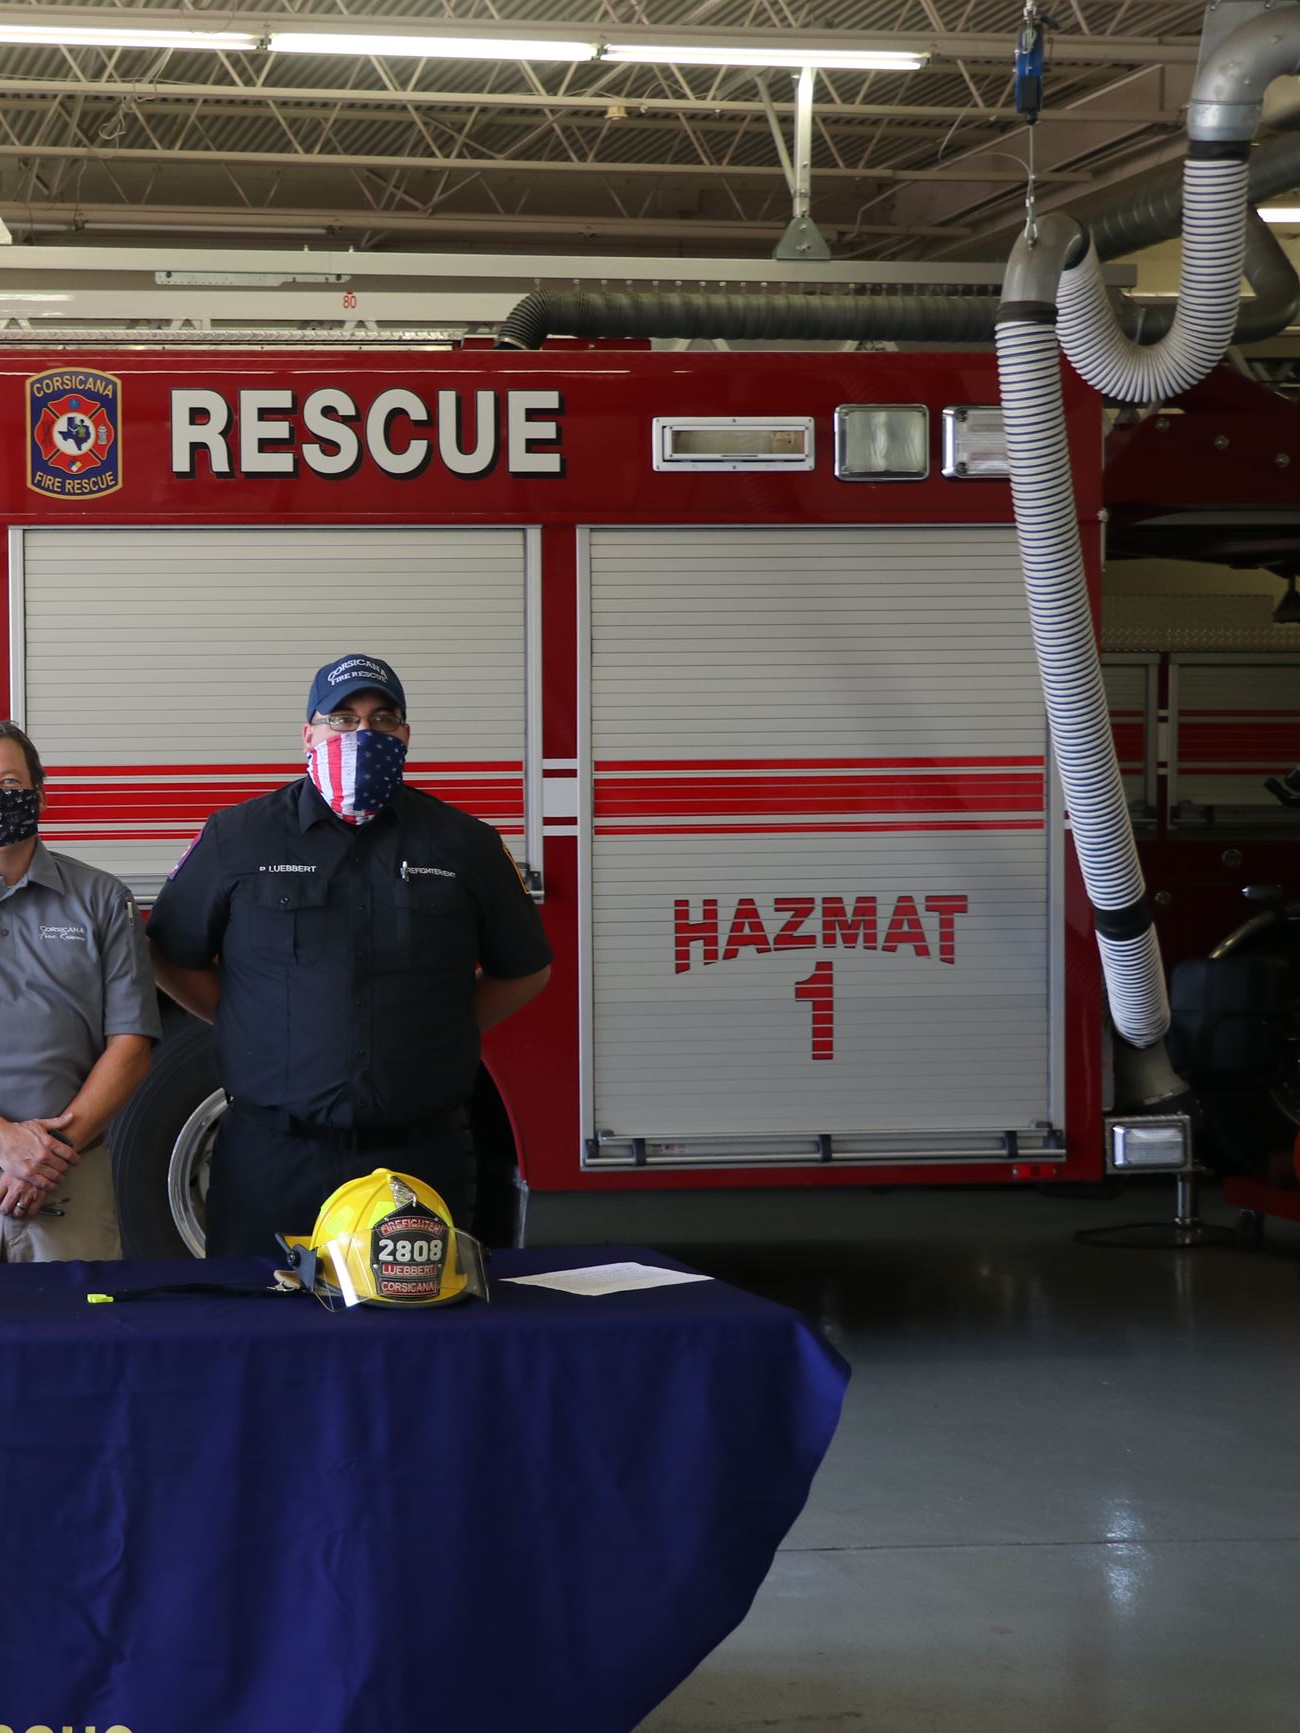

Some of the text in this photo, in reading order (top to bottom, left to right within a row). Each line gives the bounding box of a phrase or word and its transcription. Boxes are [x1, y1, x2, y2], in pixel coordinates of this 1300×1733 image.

[343, 294, 357, 309] 80
[33, 375, 113, 399] CORSICANA
[170, 388, 564, 479] RESCUE
[34, 471, 115, 493] FIRE RESCUE
[328, 659, 388, 681] CORSICANA
[331, 671, 387, 685] FIRE RESCUE
[39, 925, 85, 934] CORSICANA
[674, 894, 968, 974] HAZMAT
[795, 960, 834, 1060] 1
[378, 1239, 443, 1262] 2808
[382, 1263, 435, 1275] LUEBBERT
[381, 1281, 435, 1293] CORSICANA
